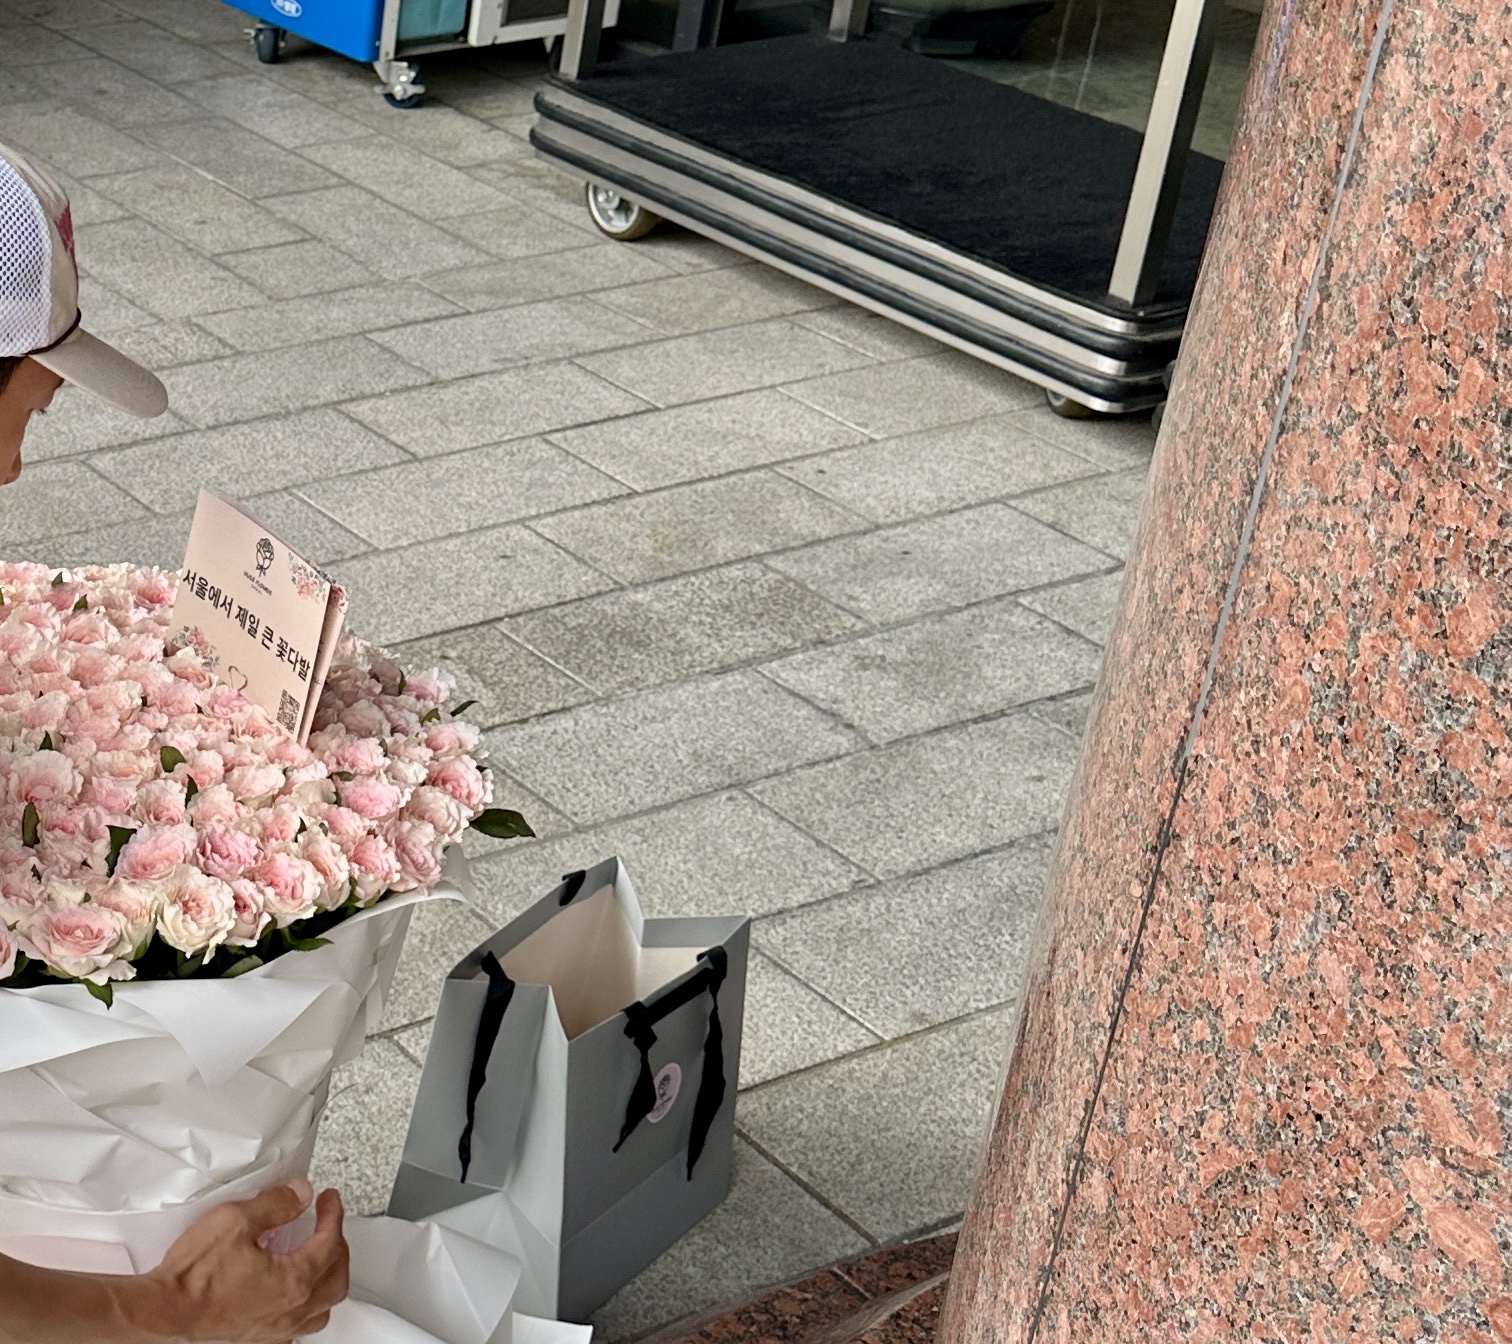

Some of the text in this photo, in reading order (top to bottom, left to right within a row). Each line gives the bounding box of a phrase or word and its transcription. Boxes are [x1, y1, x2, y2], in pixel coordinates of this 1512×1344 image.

[182, 568, 311, 682] 서울에서 제일 큰 꽃다발
